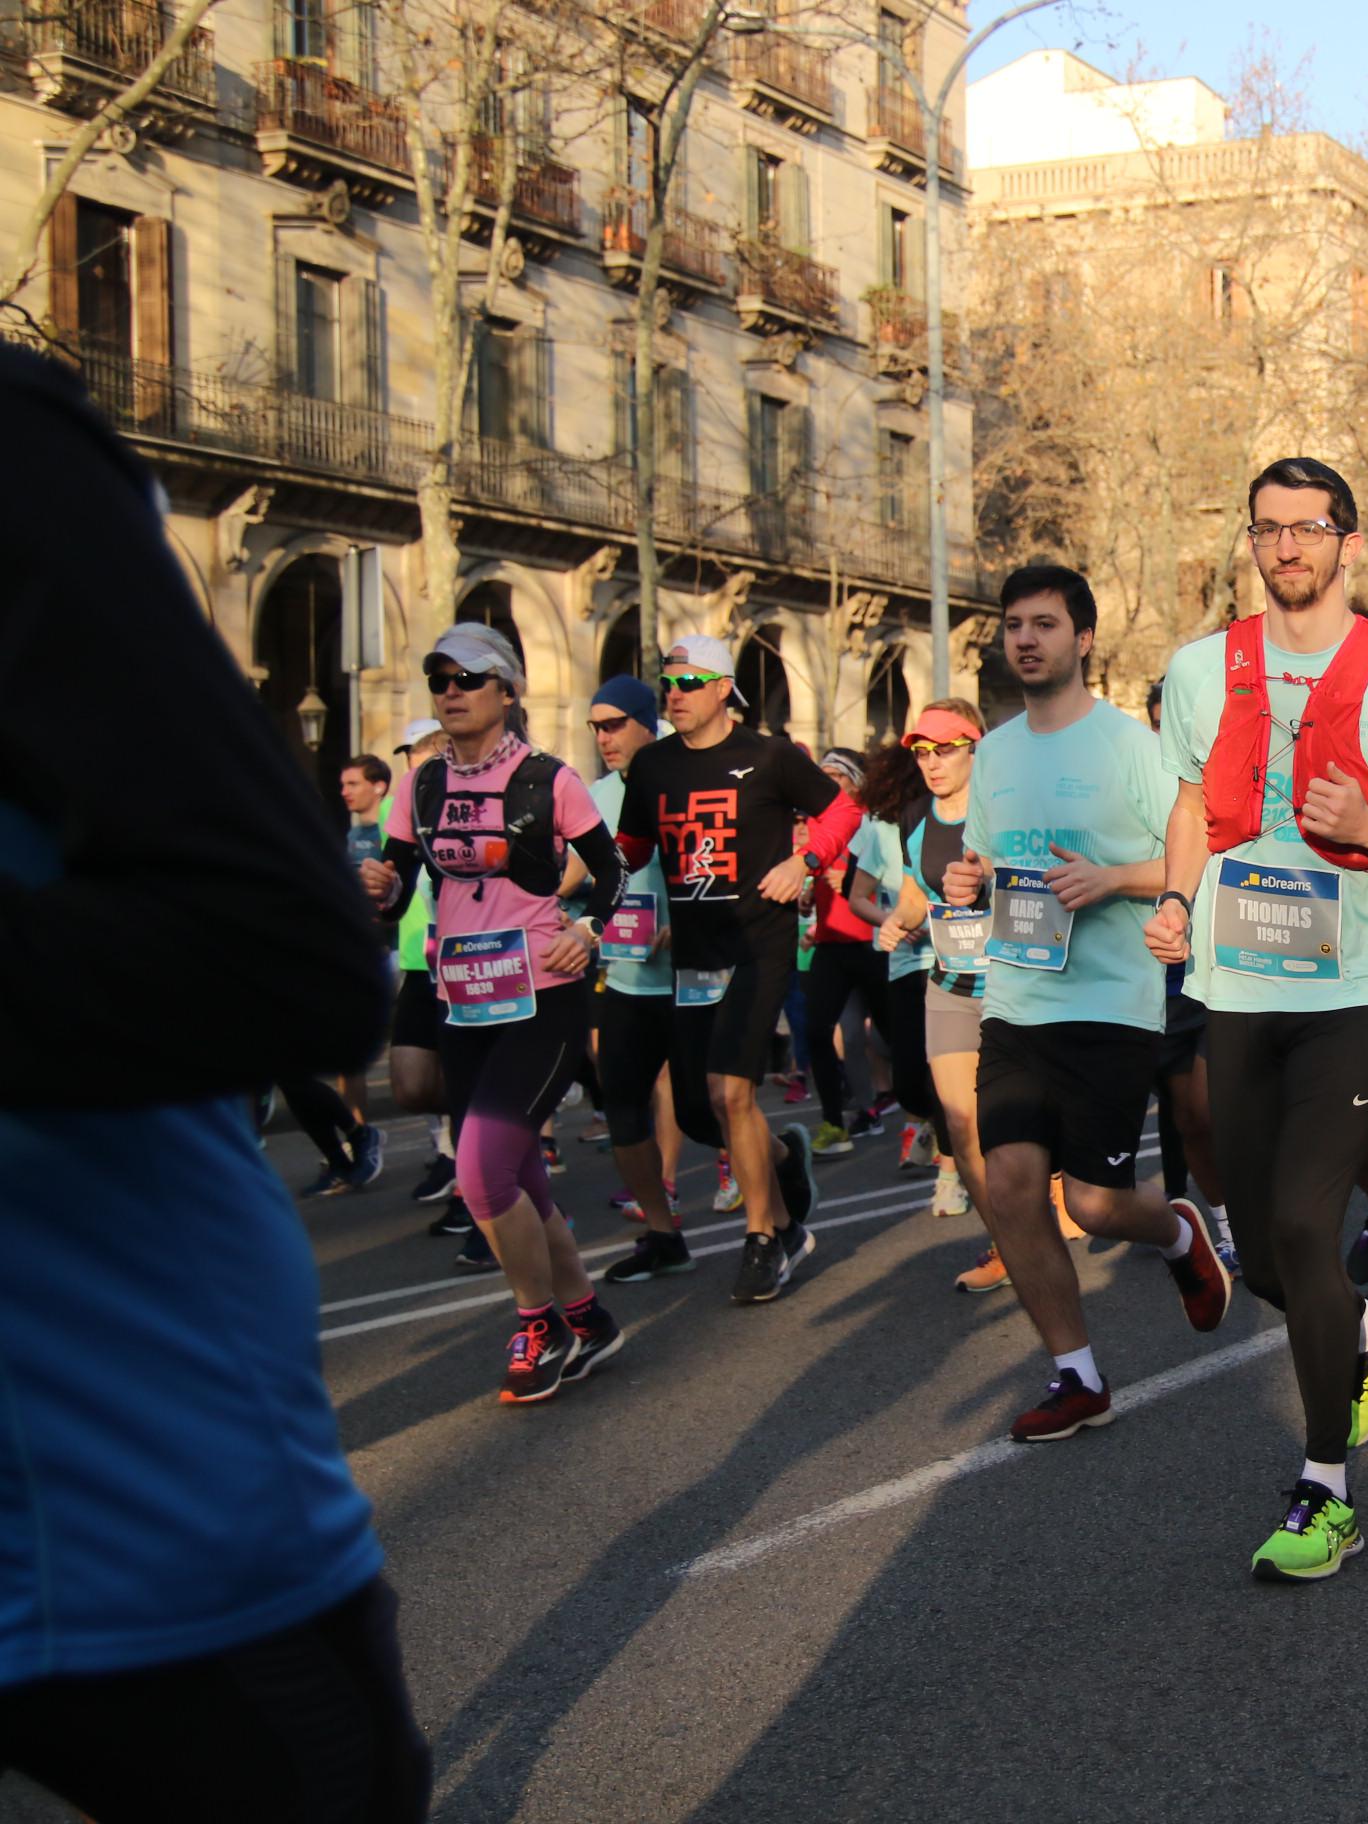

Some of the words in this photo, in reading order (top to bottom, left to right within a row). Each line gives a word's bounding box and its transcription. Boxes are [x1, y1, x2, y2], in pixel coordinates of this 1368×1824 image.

[1261, 875, 1312, 892] eDreams
[1009, 898, 1044, 920] MARC
[1237, 898, 1312, 929] THOMAS
[1256, 926, 1291, 945] 11943
[463, 939, 503, 953] eDreams
[442, 957, 524, 982] ANNE-LAURE
